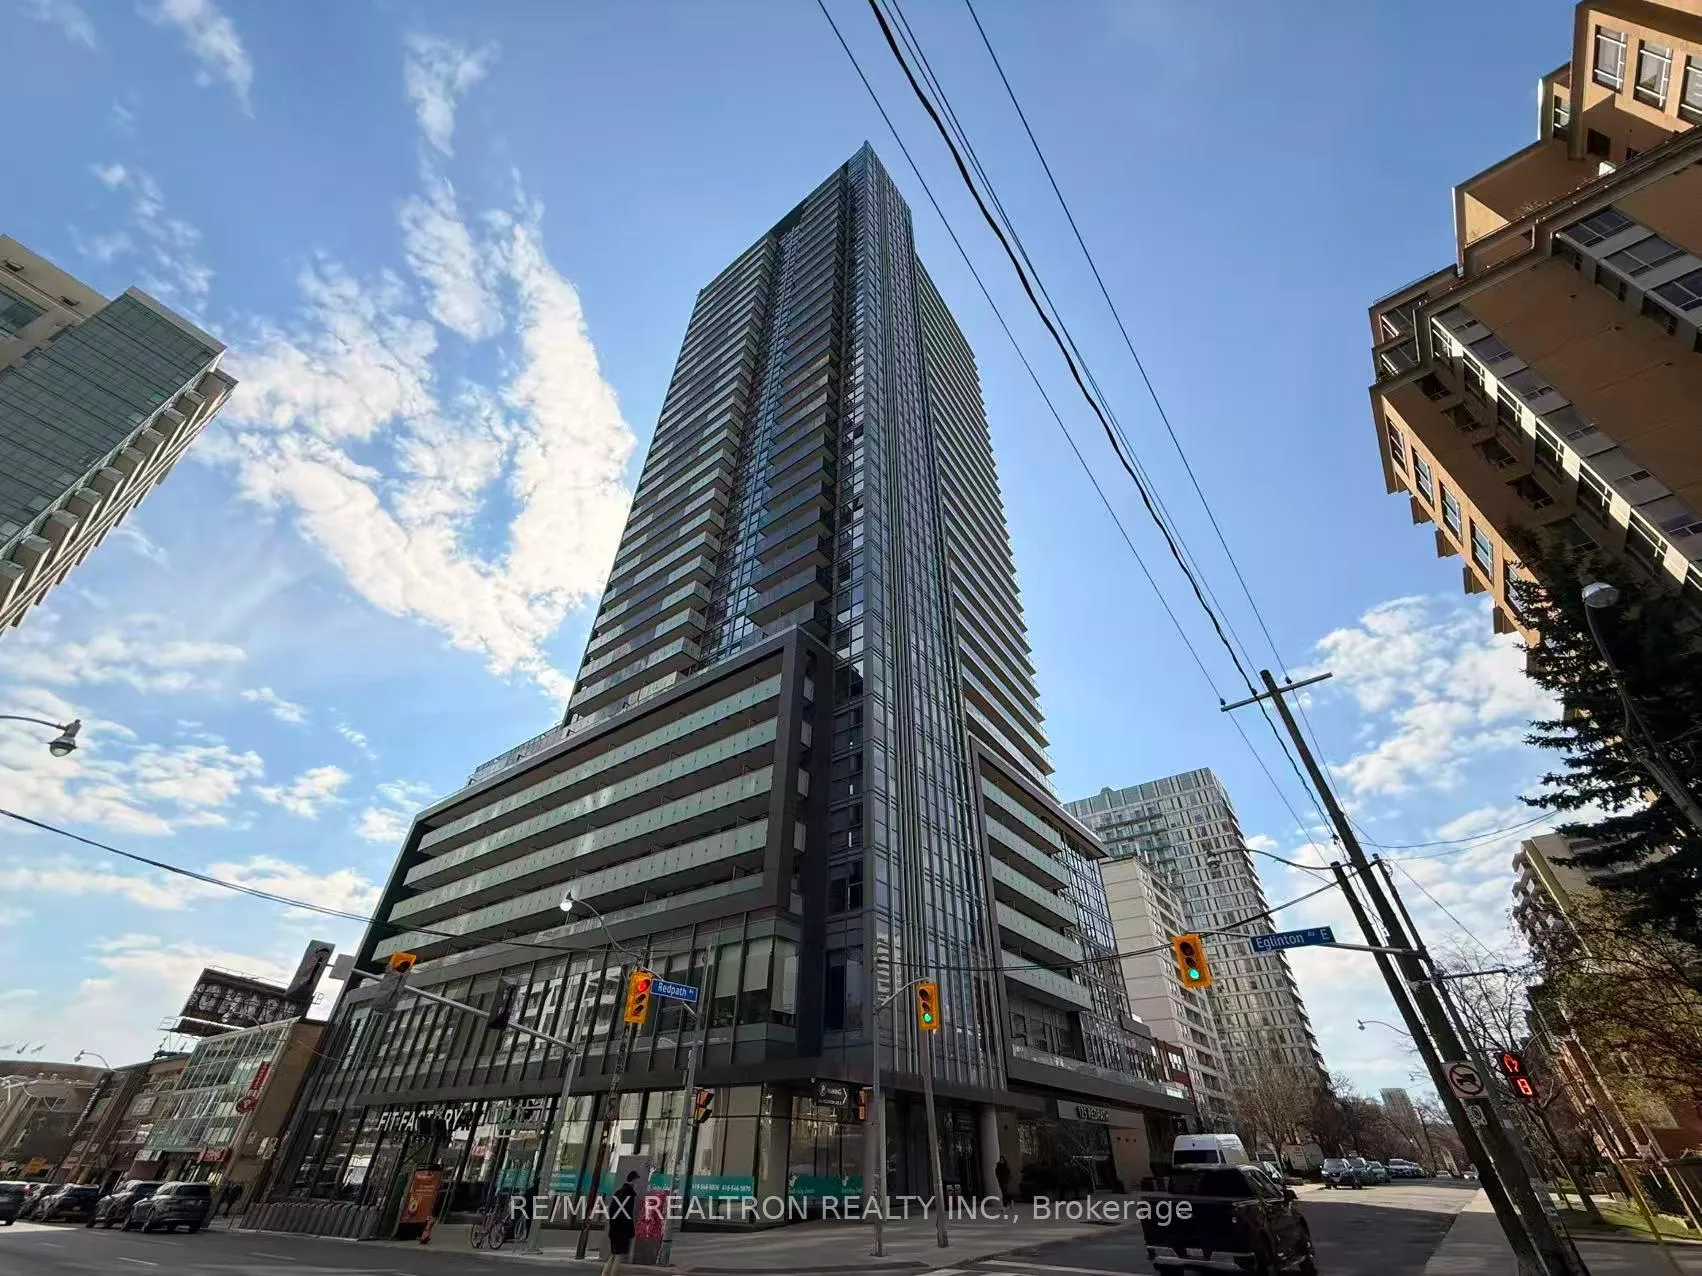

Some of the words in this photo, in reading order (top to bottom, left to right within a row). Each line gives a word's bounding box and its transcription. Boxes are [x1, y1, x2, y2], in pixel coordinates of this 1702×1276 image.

[1256, 934, 1305, 950] Eglinton
[1320, 928, 1330, 940] E
[658, 982, 687, 997] Redpath
[377, 1111, 400, 1132] FIT
